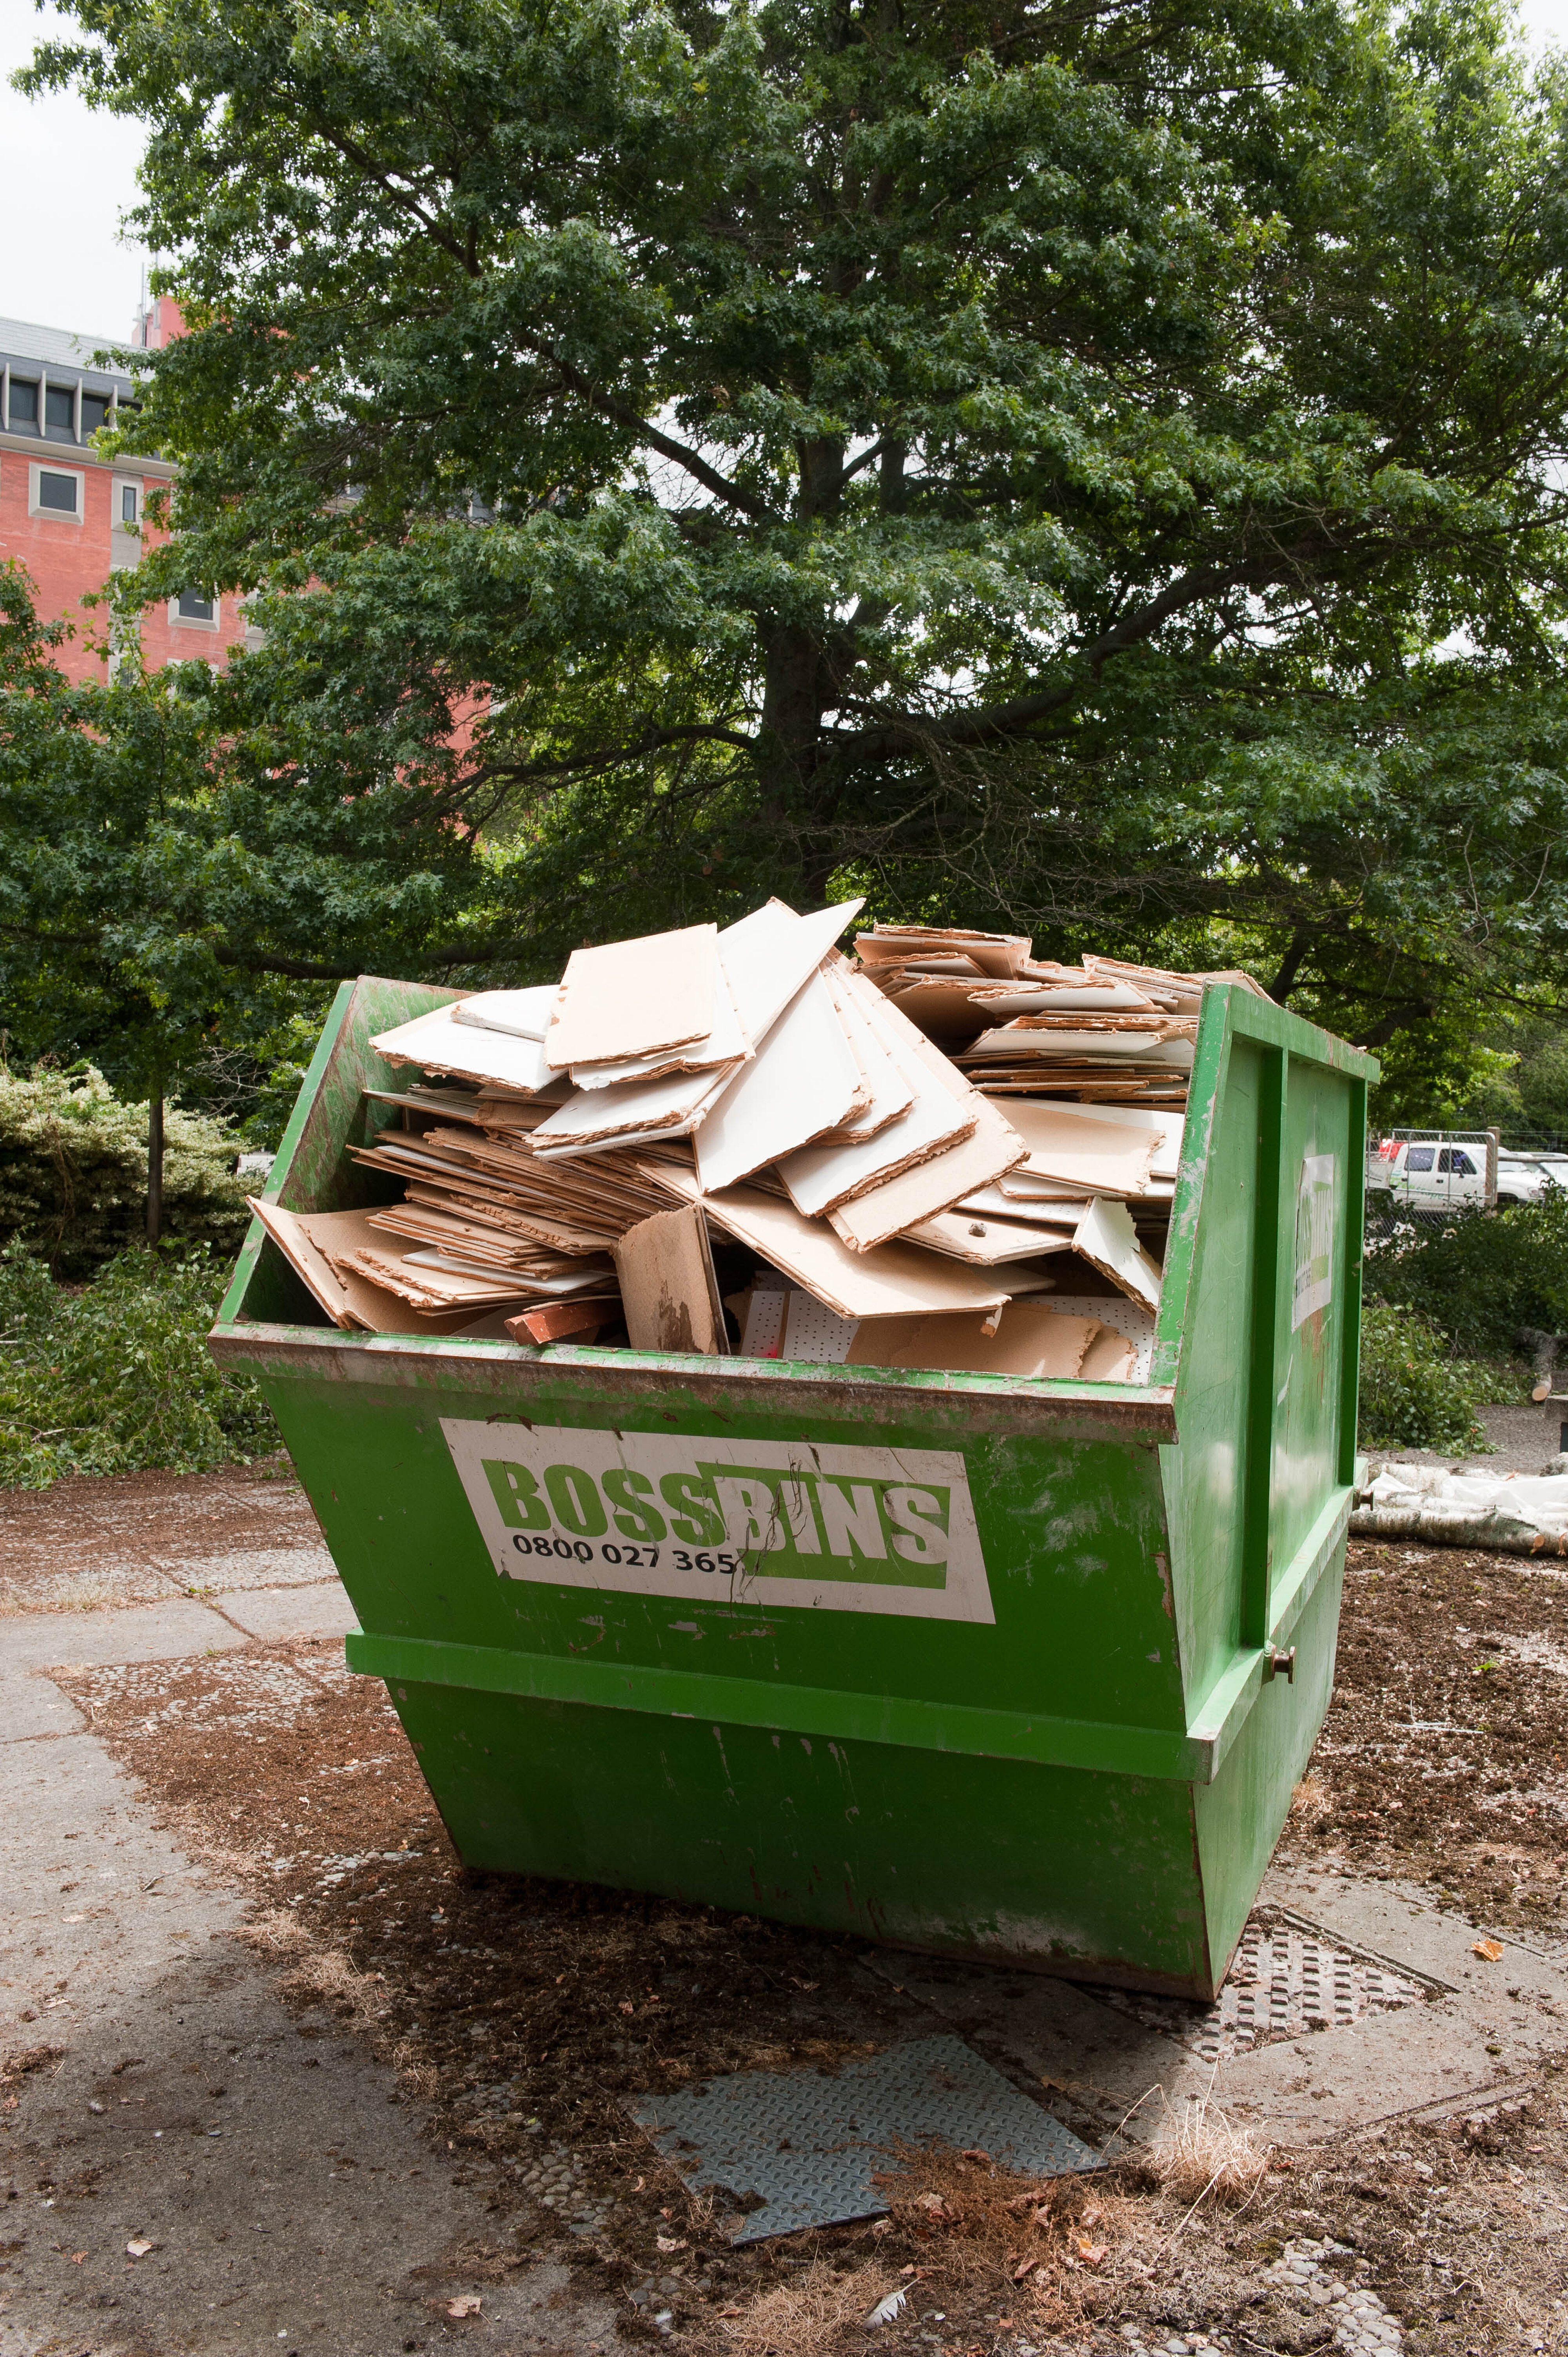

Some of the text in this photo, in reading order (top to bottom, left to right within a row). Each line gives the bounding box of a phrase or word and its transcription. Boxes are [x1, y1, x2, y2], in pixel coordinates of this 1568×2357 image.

[513, 1534, 737, 1574] 0800 027 365
